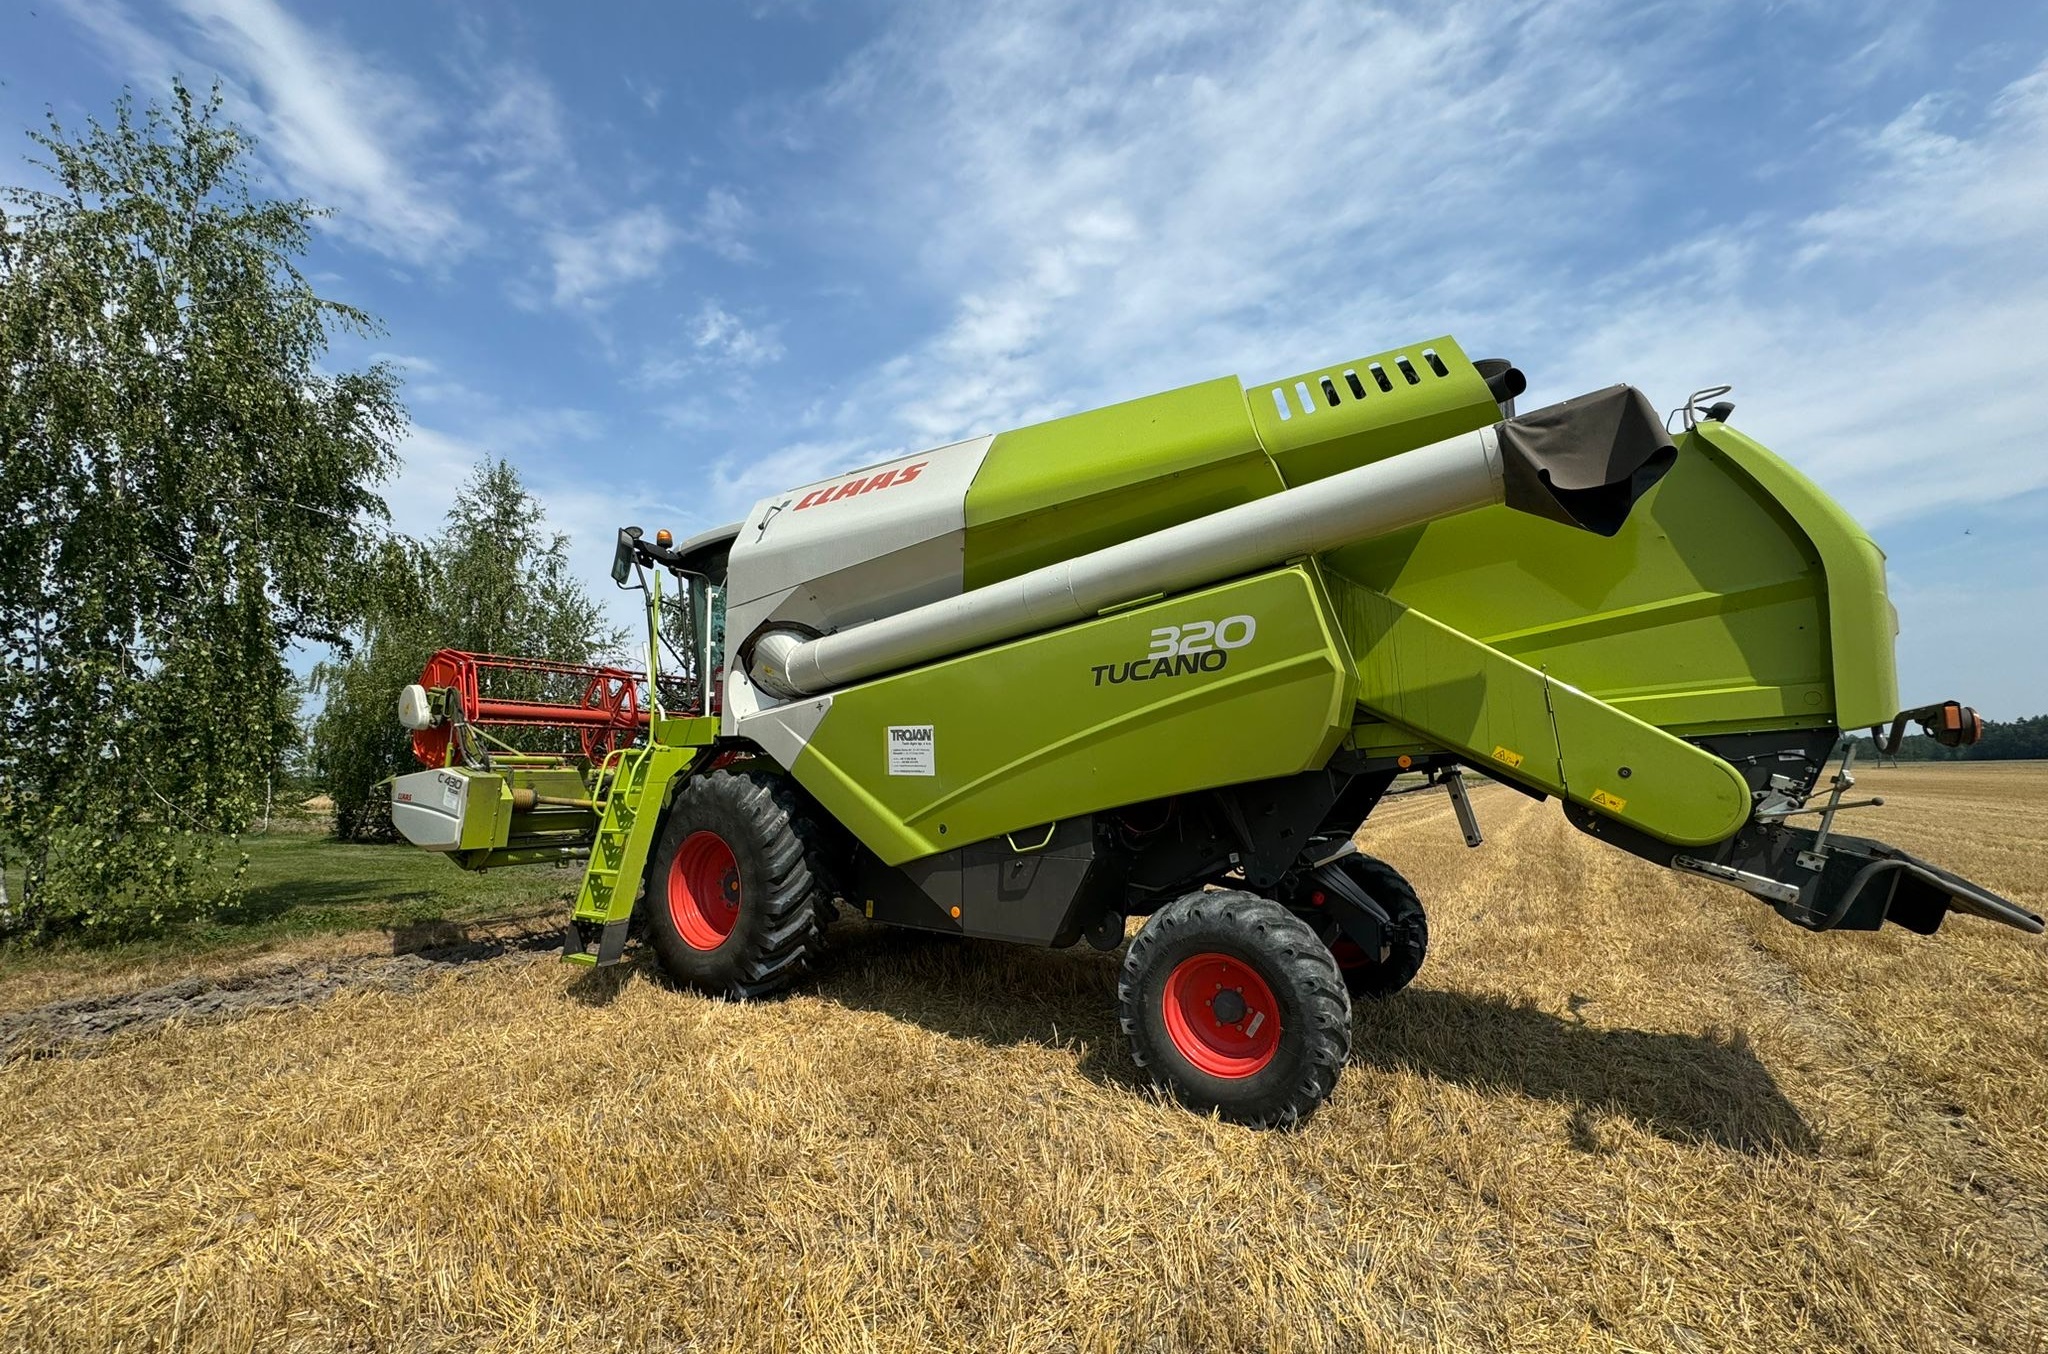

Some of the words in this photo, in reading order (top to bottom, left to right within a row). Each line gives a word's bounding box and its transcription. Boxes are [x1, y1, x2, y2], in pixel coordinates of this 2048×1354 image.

[793, 461, 929, 512] CLAAS
[1148, 614, 1257, 660] 320
[1091, 649, 1228, 687] TUCANO
[890, 728, 932, 741] TROJAN
[438, 773, 444, 783] C
[445, 776, 463, 790] 430
